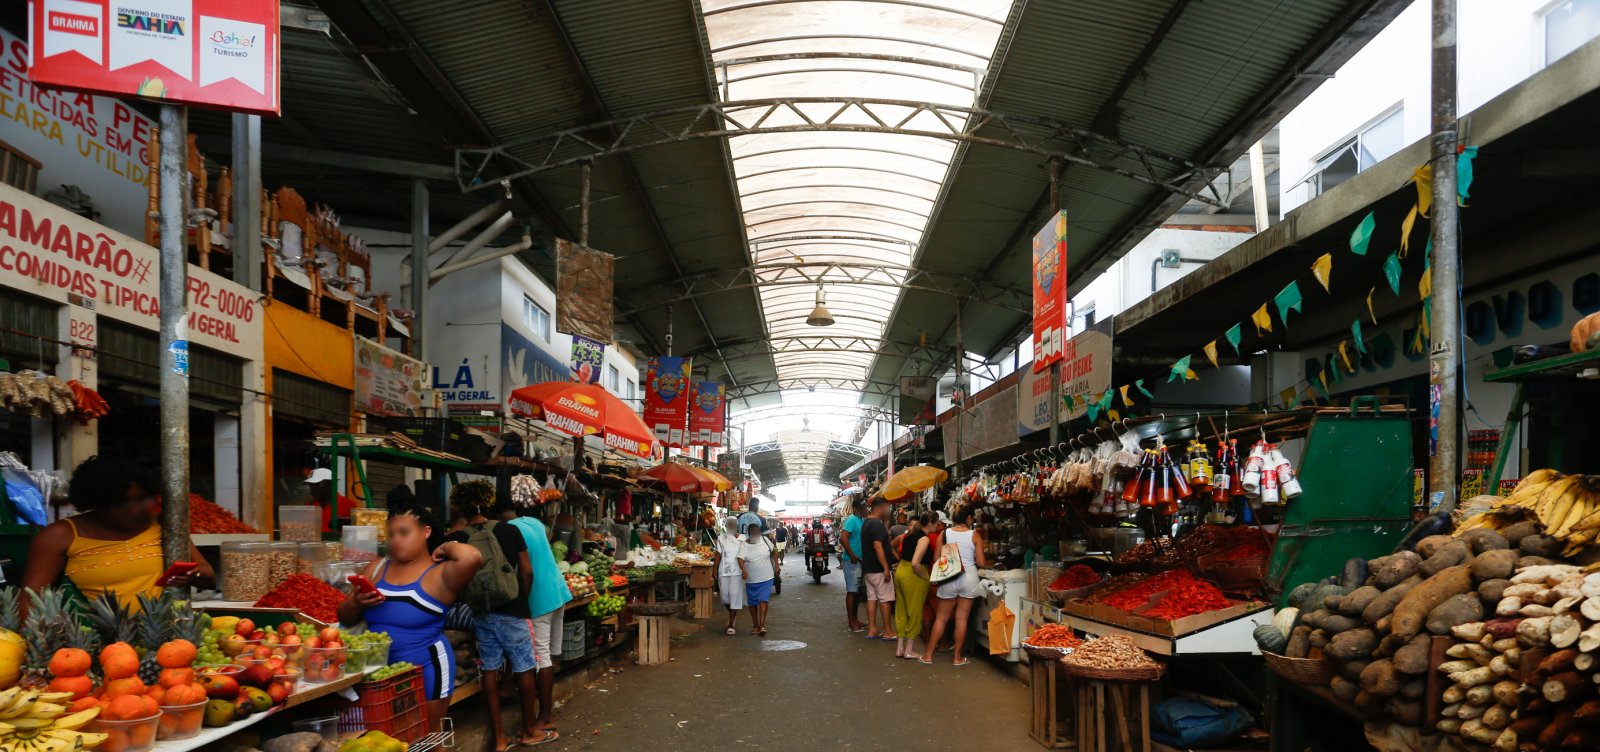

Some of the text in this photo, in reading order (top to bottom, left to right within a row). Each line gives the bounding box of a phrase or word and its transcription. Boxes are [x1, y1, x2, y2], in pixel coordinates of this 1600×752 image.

[52, 16, 95, 32] BRAHMA
[118, 8, 149, 17] GOVERNO
[161, 14, 185, 22] ESTADO
[209, 30, 256, 48] Bahia!
[213, 48, 248, 58] TURISMO
[106, 126, 132, 157] EM
[77, 133, 151, 188] UTILID
[0, 246, 161, 319] COMIDAS TIPICA
[70, 319, 94, 341] B22
[198, 315, 240, 344] GERAL
[442, 390, 496, 401] EM GERAL.
[558, 397, 600, 418] BRAHMA
[605, 432, 639, 454] BRAHMA
